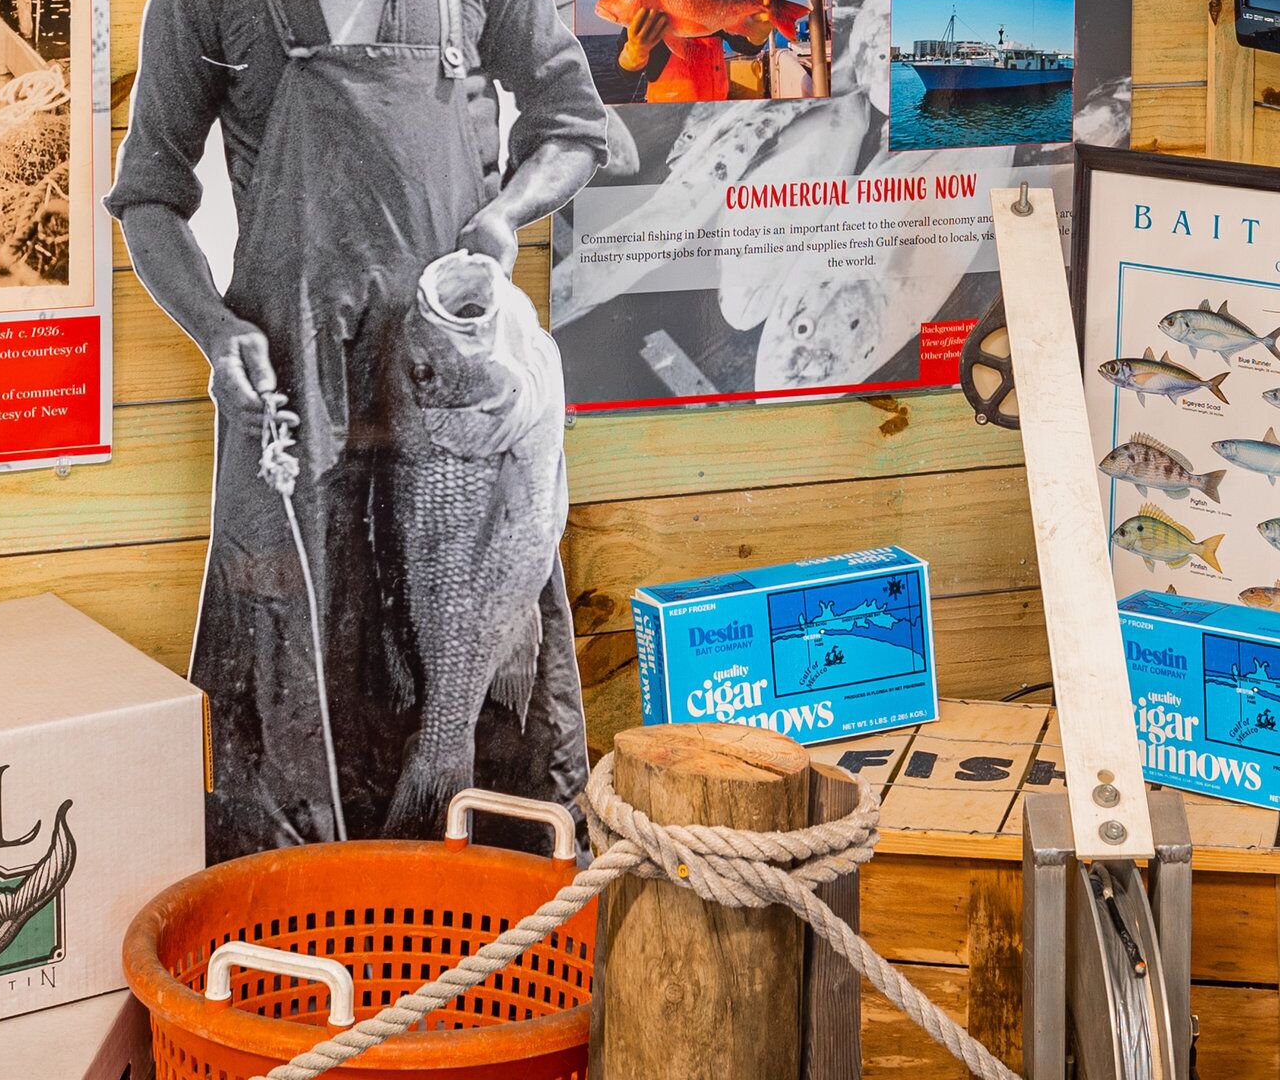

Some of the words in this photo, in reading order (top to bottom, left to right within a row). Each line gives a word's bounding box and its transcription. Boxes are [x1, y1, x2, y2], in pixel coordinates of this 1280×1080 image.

[725, 178, 850, 210] COMMERCIAL
[857, 176, 926, 203] FISHING
[934, 174, 976, 200] NOW
[1134, 204, 1261, 245] BAIT
[668, 607, 687, 616] KEEP
[688, 602, 716, 613] FROZEN
[688, 621, 754, 648] Destin
[1127, 619, 1154, 630] FROZEN
[695, 646, 712, 656] BAIT
[714, 639, 753, 653] COMPANY
[1127, 640, 1188, 671] Destin
[714, 664, 749, 684] quality
[686, 678, 768, 721] cigar
[1130, 697, 1200, 744] igar
